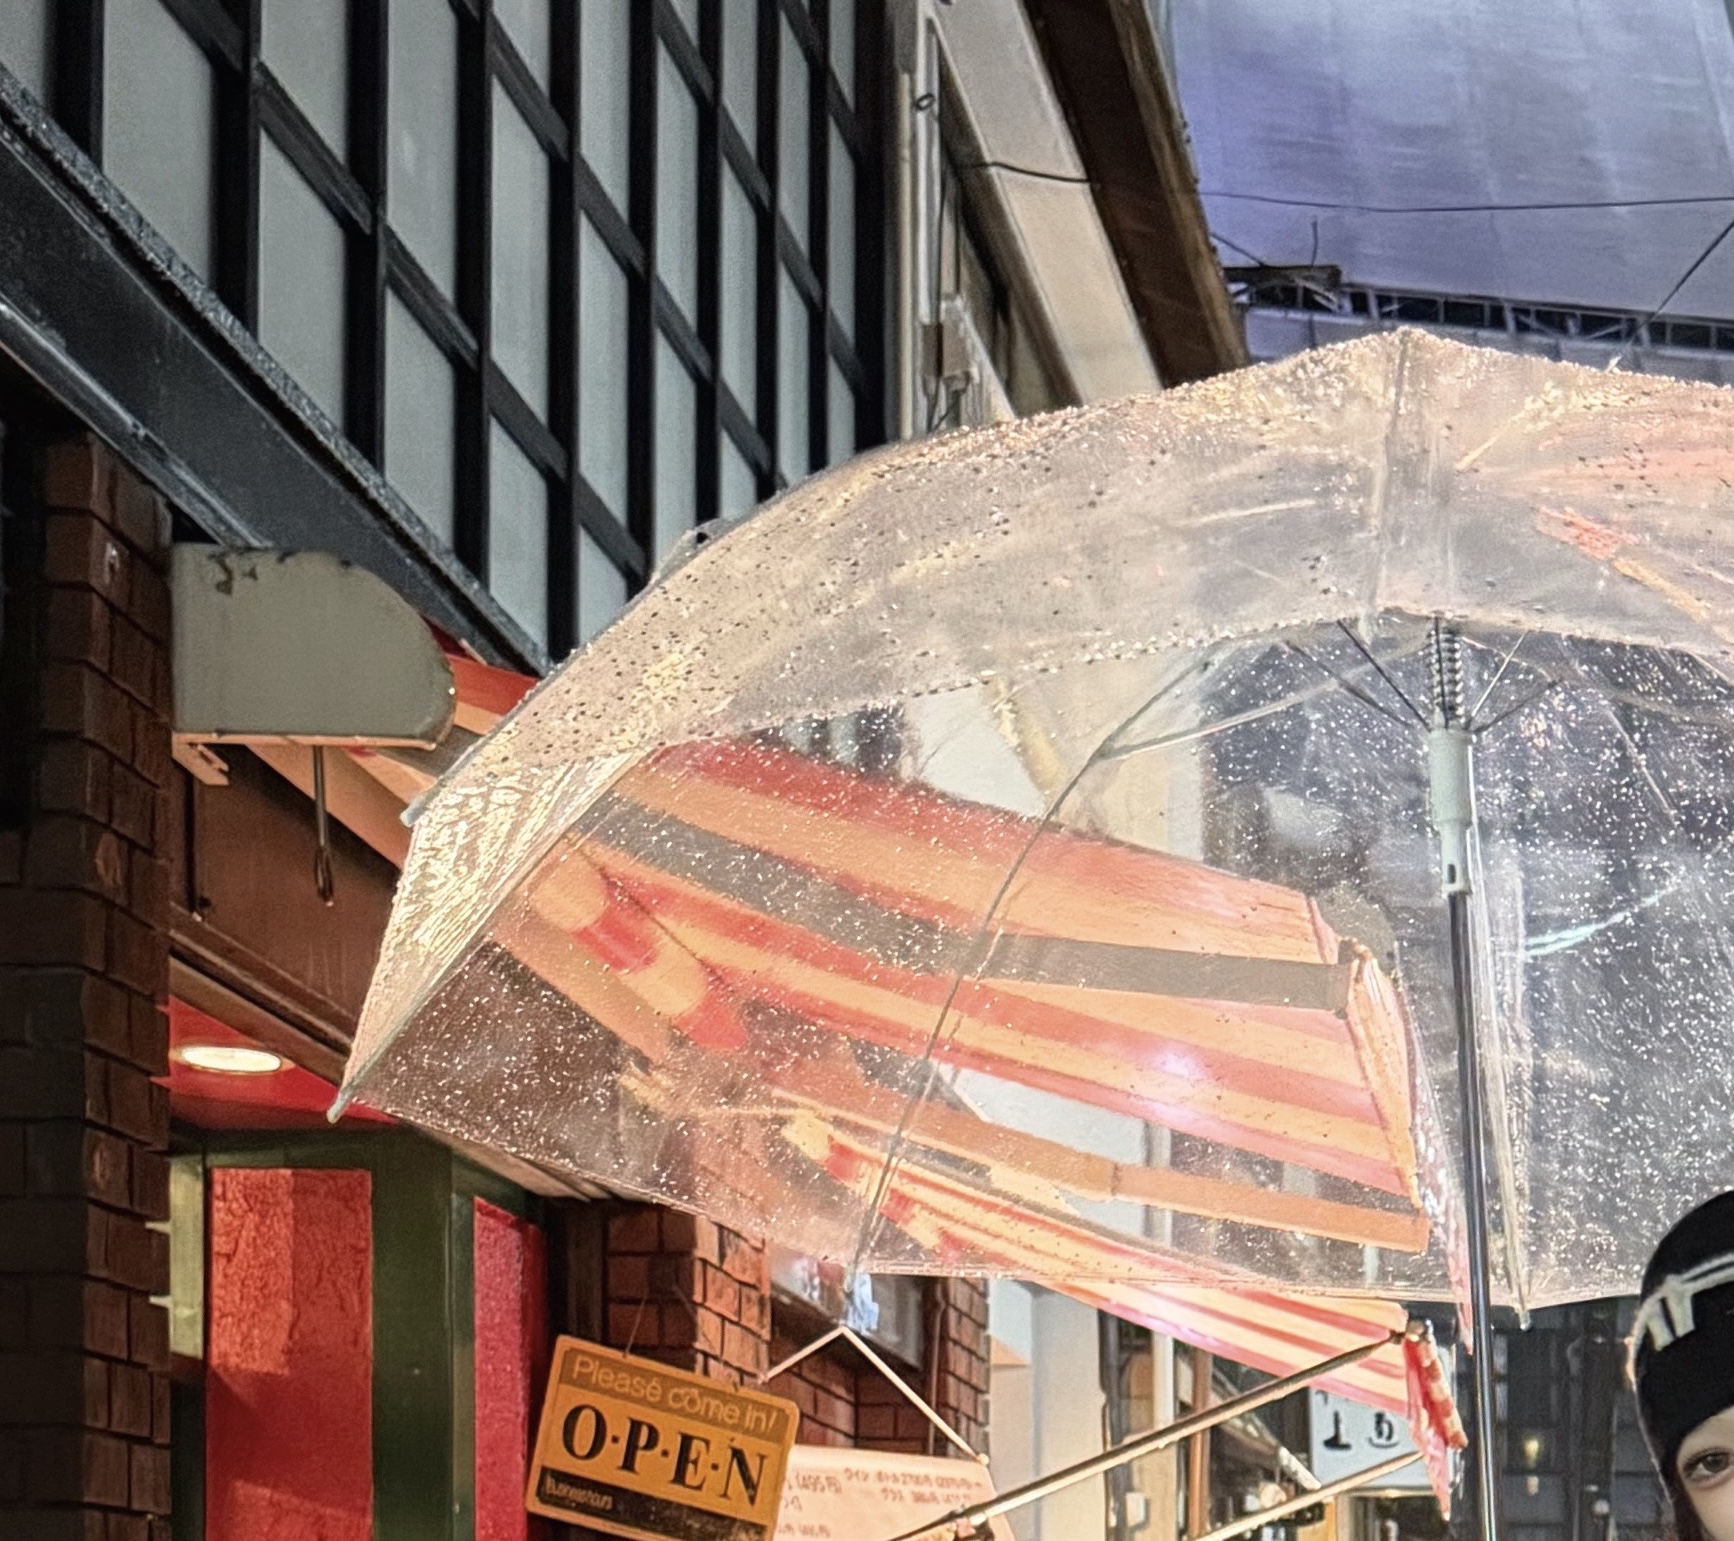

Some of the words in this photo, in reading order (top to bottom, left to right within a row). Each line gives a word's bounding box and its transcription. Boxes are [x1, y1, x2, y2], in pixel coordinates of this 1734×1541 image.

[571, 1355, 663, 1401] Please
[668, 1385, 740, 1426] come
[744, 1406, 777, 1433] in!
